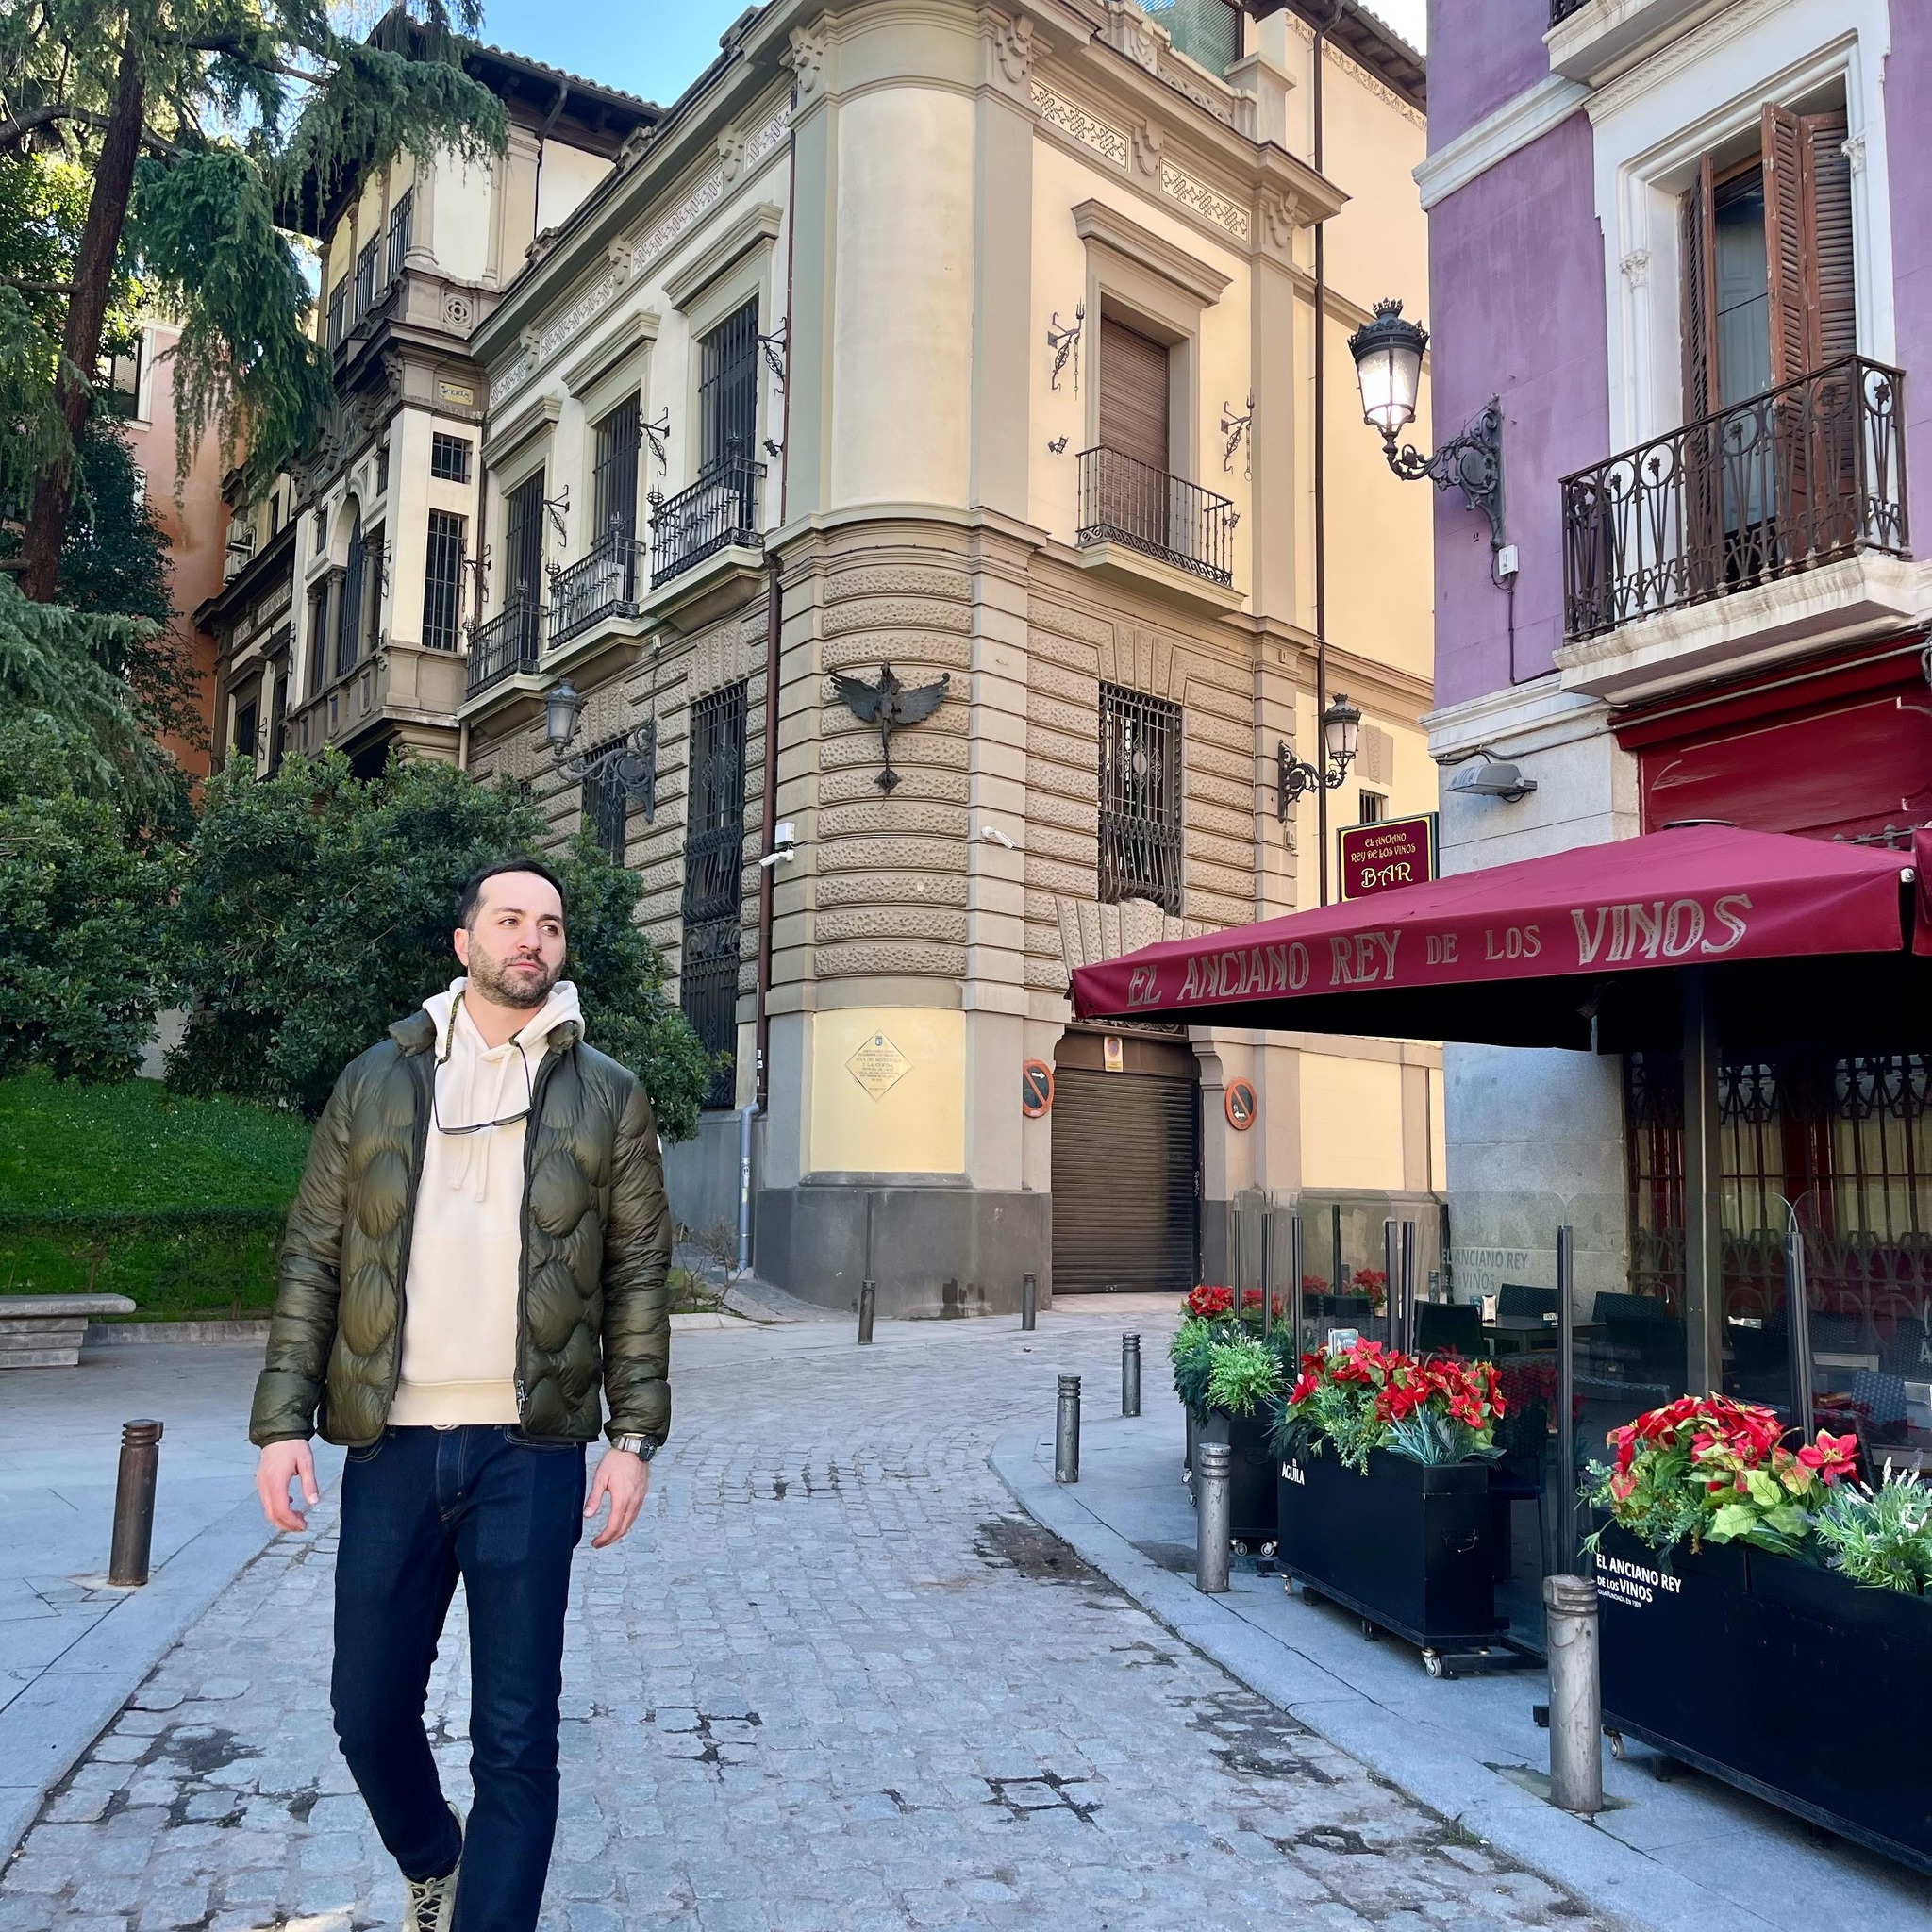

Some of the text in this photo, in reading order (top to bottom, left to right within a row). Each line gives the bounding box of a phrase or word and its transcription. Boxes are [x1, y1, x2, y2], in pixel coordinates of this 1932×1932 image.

[1351, 843, 1416, 862] REY DE LOS VINOS
[1365, 833, 1407, 847] EL ANCIANO
[1361, 862, 1413, 888] BAR
[1126, 893, 1754, 1008] EL ANCIANO REY DE LOS VINOS
[1454, 1248, 1504, 1269] ANCIANO
[1507, 1251, 1529, 1271] REY
[1596, 1553, 1681, 1593] EL ANCIANO REY
[1596, 1575, 1653, 1602] DE LOS VINOS
